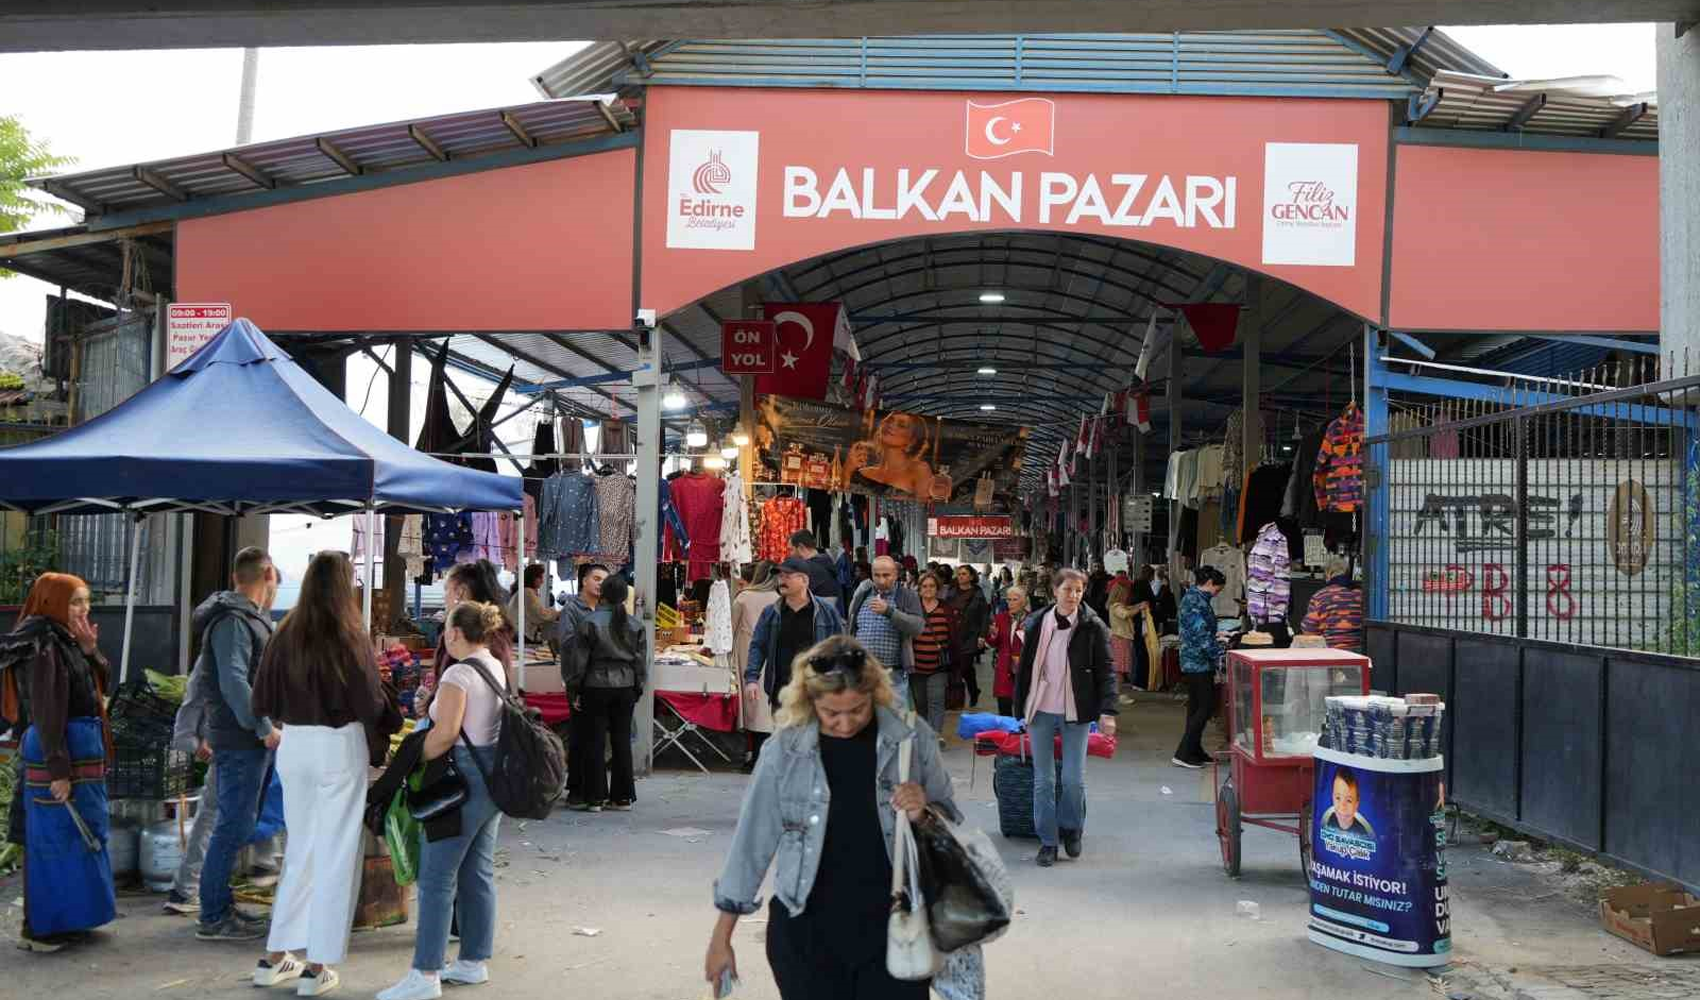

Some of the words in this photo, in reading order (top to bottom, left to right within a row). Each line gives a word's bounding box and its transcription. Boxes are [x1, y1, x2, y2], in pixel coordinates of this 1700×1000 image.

[783, 166, 1022, 223] BALKAN
[1039, 172, 1237, 229] PAZARI
[1288, 181, 1334, 206] Filiz
[680, 199, 745, 217] Edirne
[1271, 204, 1349, 221] GENCAN
[734, 329, 760, 343] ÖN
[731, 353, 766, 366] YOL
[940, 525, 978, 536] BALKAN
[980, 525, 1011, 536] PAZARI
[1310, 861, 1351, 884] AŞAMAK
[1353, 870, 1407, 895] İSTİYOR!
[1331, 886, 1362, 903] TUTAR
